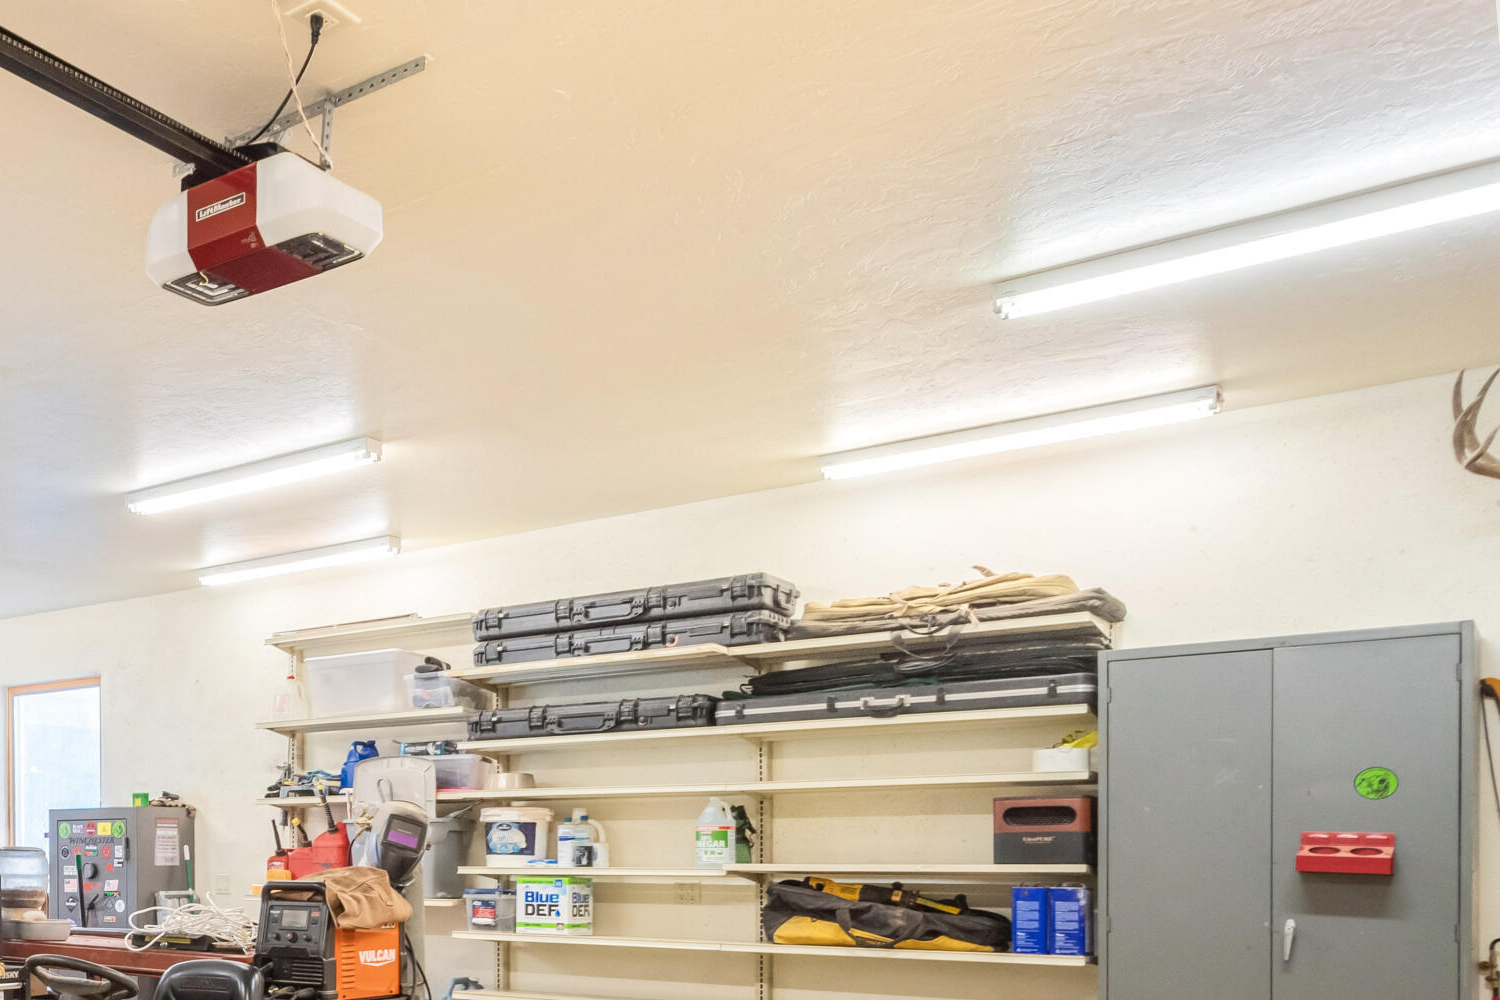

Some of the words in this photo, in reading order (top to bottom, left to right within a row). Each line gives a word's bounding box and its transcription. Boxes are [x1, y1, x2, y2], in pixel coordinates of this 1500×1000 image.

[200, 198, 242, 217] LiftMaster
[525, 891, 559, 903] Blue
[572, 892, 589, 904] Blue
[525, 904, 559, 916] DEF
[359, 949, 396, 962] VULCAN
